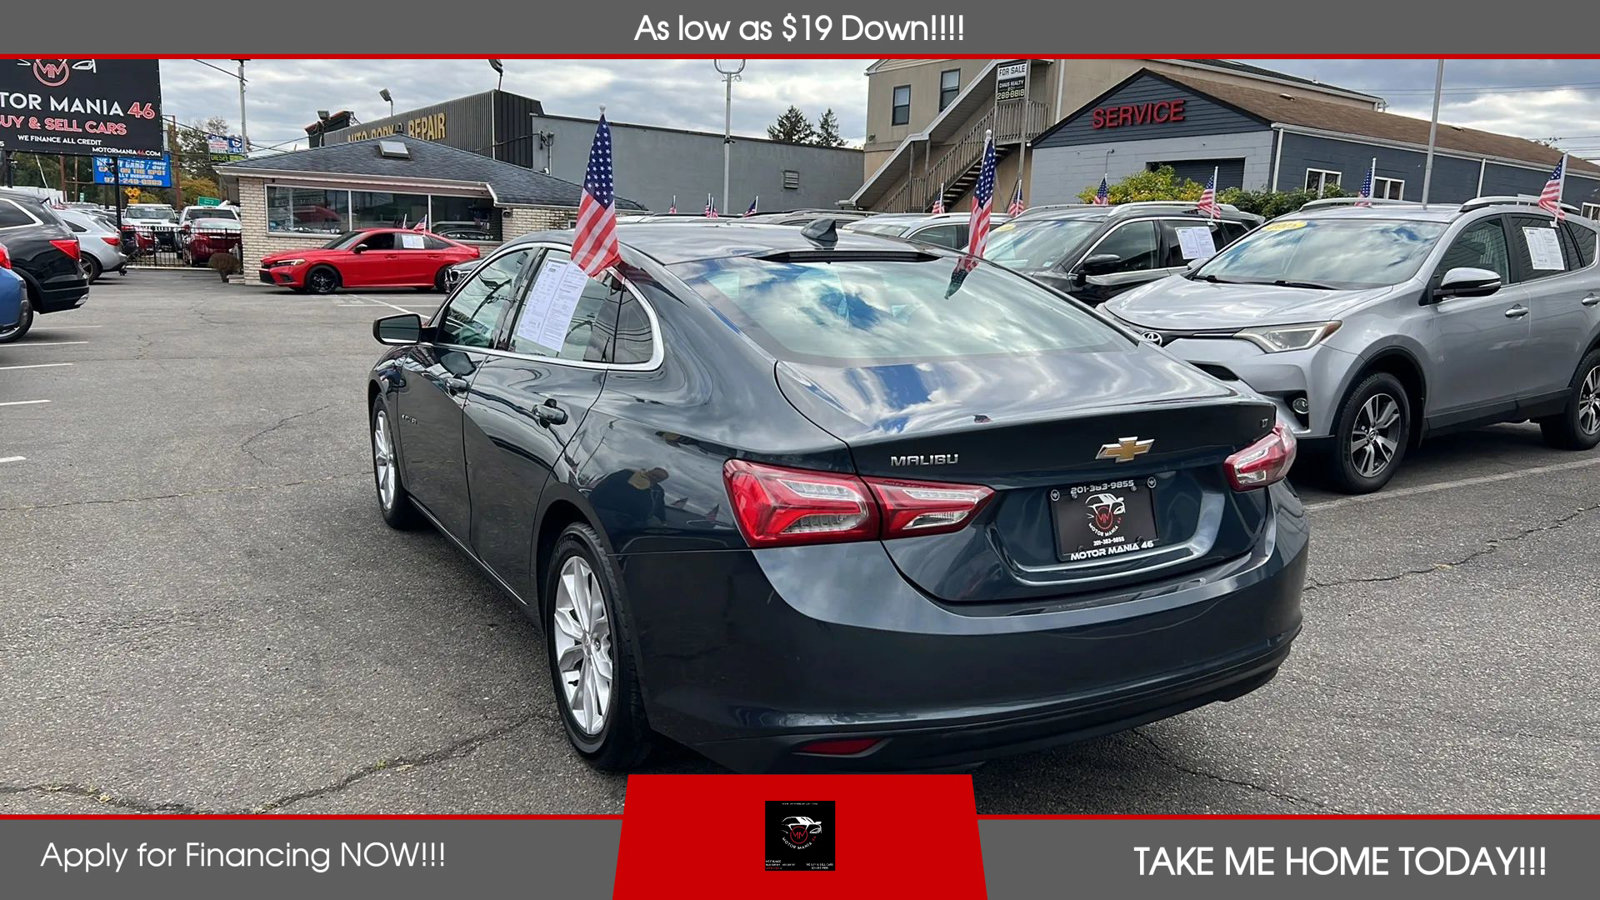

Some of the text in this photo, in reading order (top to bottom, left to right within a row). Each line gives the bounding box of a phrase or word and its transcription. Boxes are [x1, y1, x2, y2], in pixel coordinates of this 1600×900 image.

[1011, 64, 1025, 74] SALE
[50, 96, 124, 116] MANIA
[127, 102, 155, 119] 46
[1092, 99, 1184, 129] SERVICE
[0, 114, 127, 135] UY & SELL CARS
[408, 113, 445, 140] REPAIR
[30, 135, 61, 143] FINANCE
[77, 138, 102, 146] CREDIT
[890, 454, 959, 466] MALIBU
[1070, 540, 1154, 561] MOTOR MANIA 46
